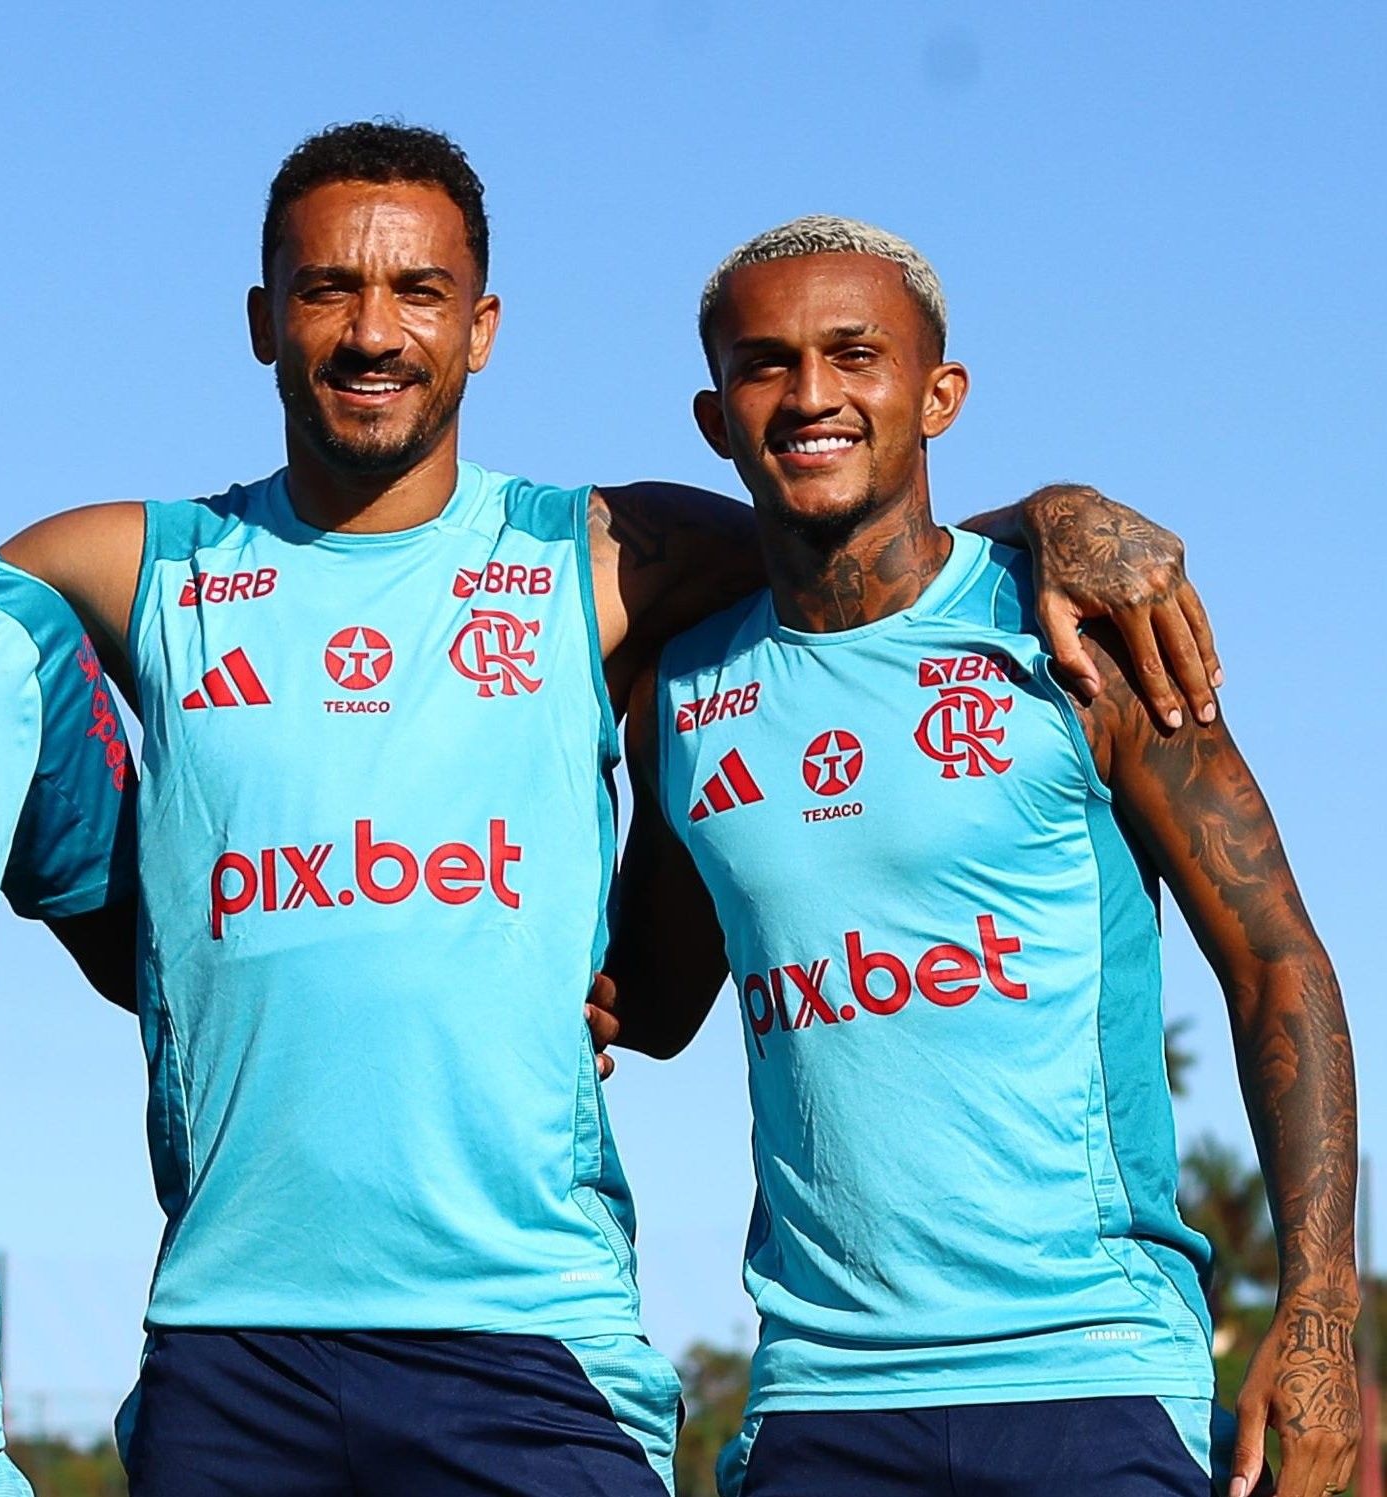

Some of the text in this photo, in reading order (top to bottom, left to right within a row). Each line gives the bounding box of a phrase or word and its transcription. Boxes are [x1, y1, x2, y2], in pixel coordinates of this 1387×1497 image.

[203, 567, 279, 604] BRB
[482, 560, 554, 596] BRB
[323, 700, 392, 714] TEXACO
[700, 681, 761, 726] BRB
[802, 802, 864, 824] TEXACO
[210, 817, 523, 941] pix.bet
[742, 913, 1029, 1060] pix.bet
